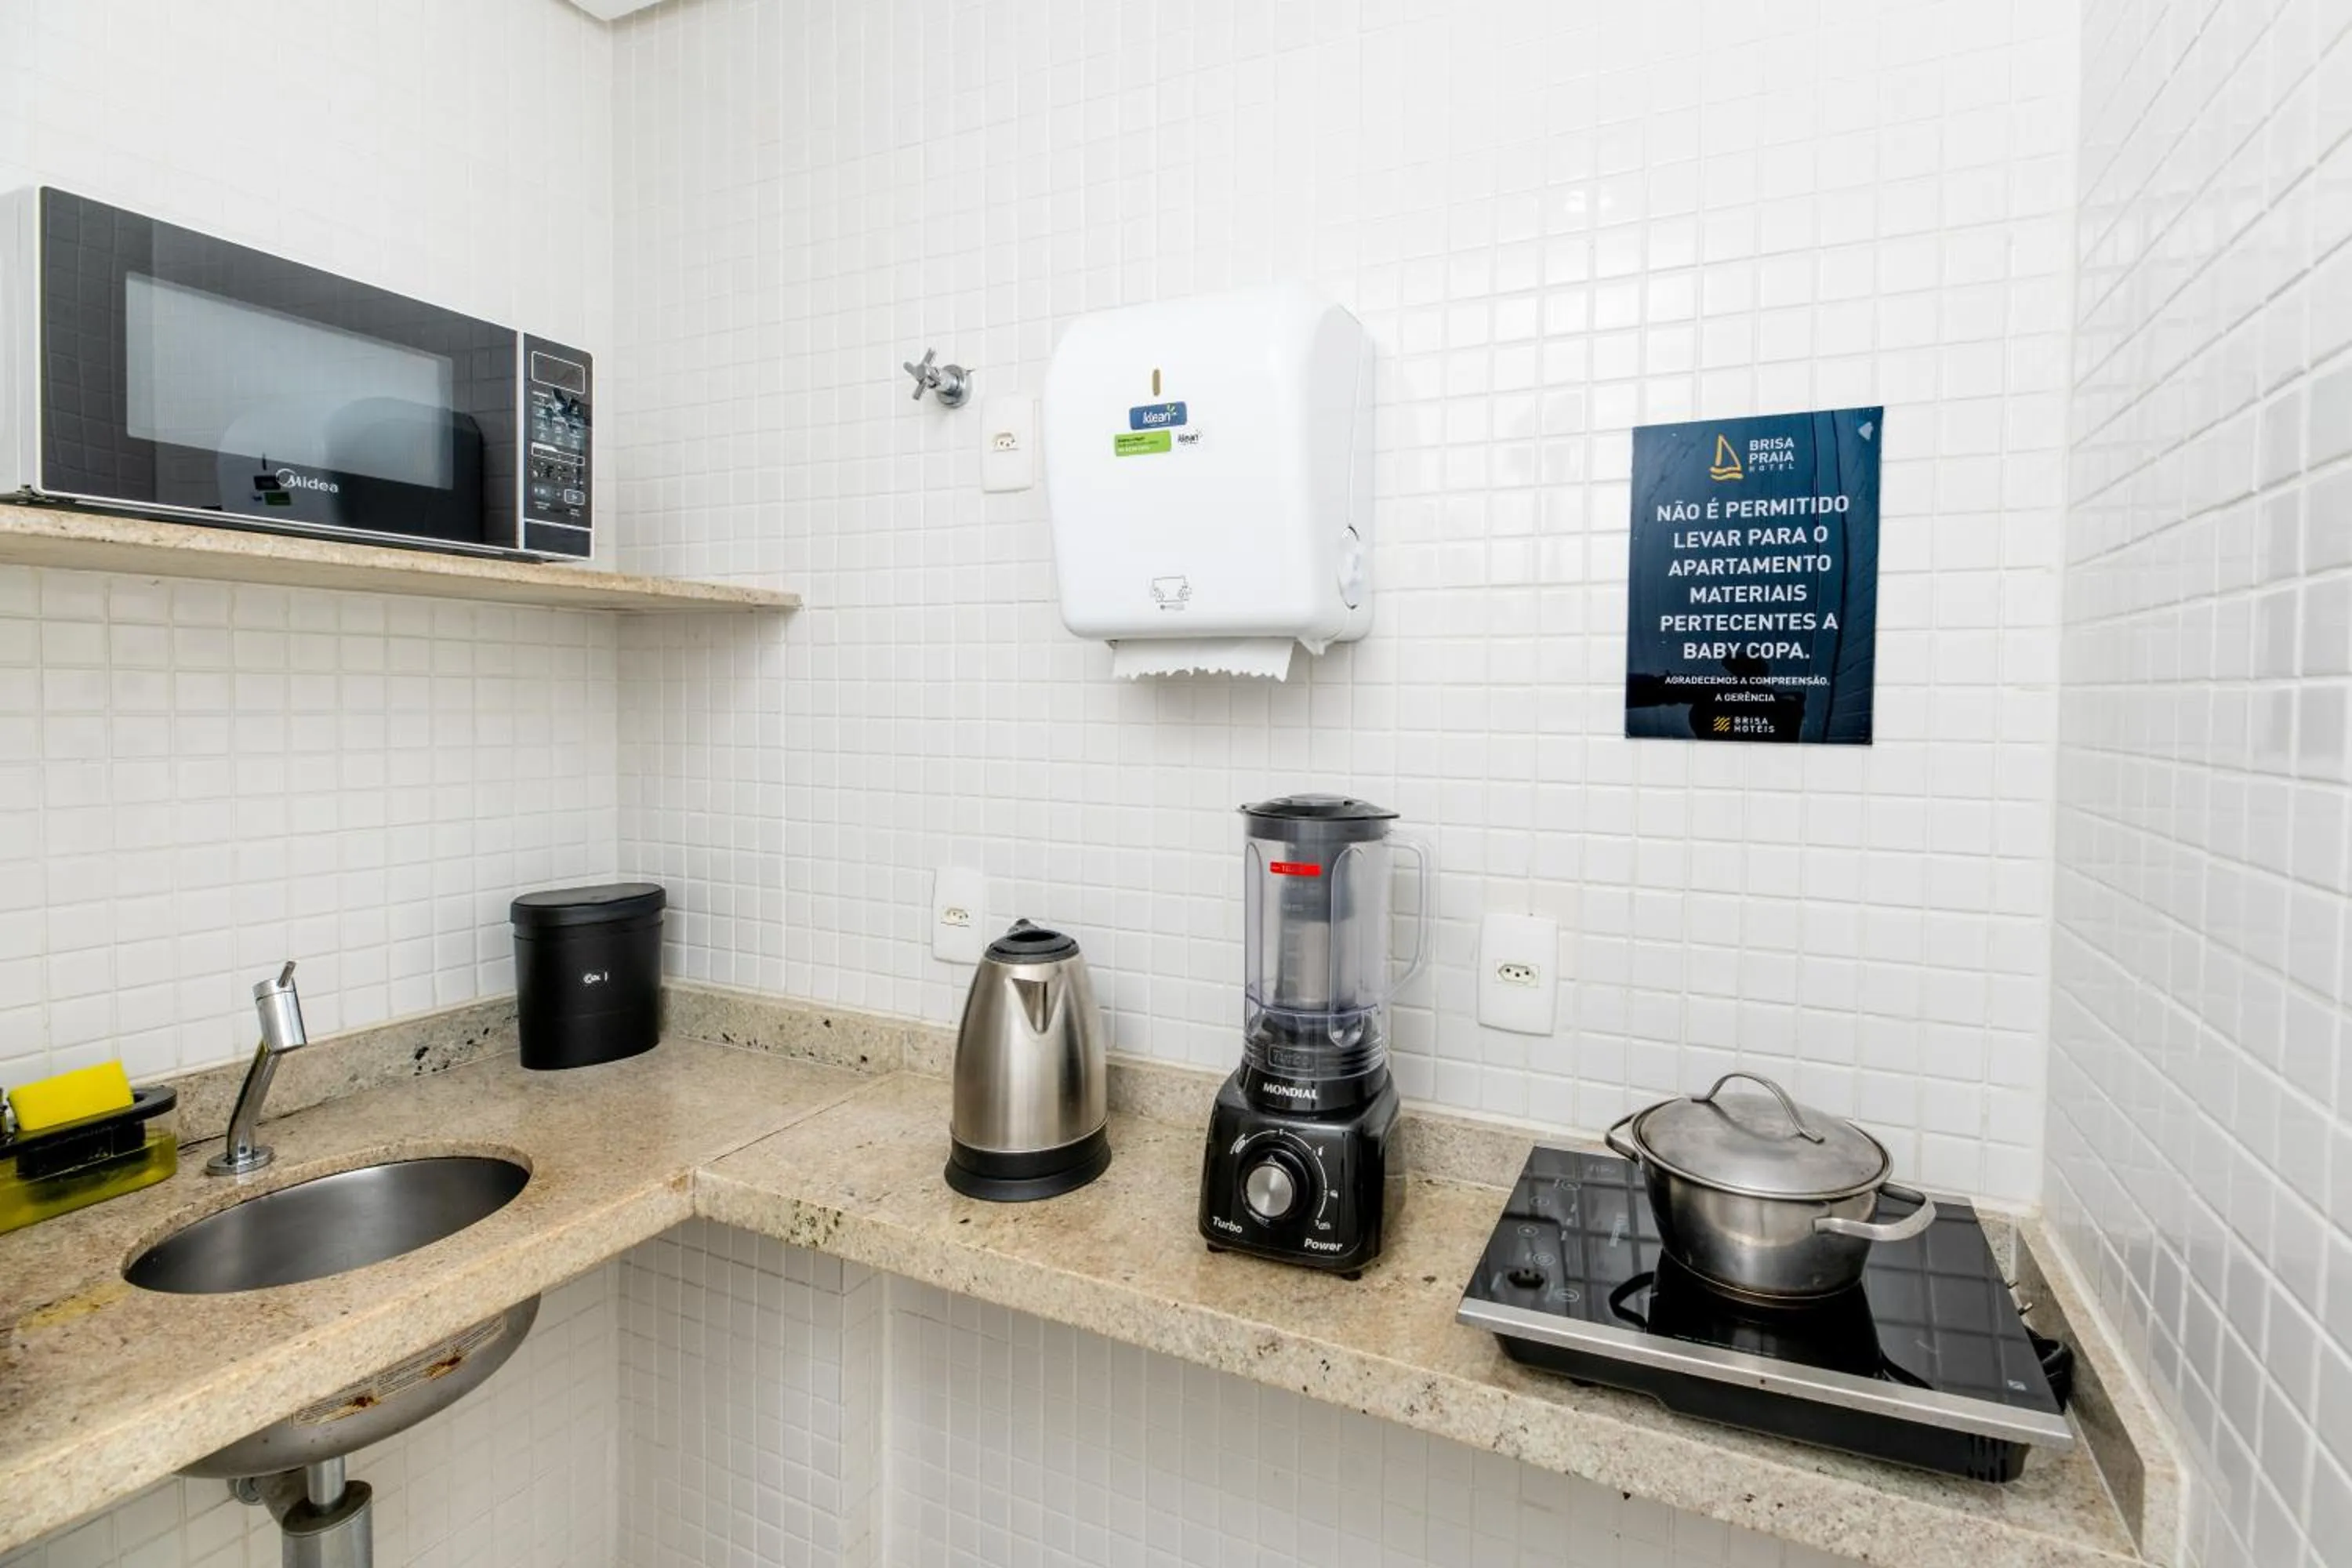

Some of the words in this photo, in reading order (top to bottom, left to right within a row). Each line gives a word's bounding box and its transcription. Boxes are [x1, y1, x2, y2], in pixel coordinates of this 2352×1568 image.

[1748, 437, 1795, 451] BRISA
[1748, 450, 1795, 464] PRAIA
[283, 472, 339, 493] Midea
[1657, 500, 1700, 521] NÃO
[1707, 497, 1719, 519] É
[1726, 495, 1849, 518] PERMITIDO
[1674, 529, 1741, 548] LEVAR
[1748, 526, 1807, 546] PARA
[1813, 525, 1828, 543] O
[1668, 554, 1832, 576] APARTAMENTO
[1690, 584, 1807, 604] MATERIAIS
[1660, 612, 1817, 632] PERTECENTES
[1822, 612, 1838, 630] A
[1683, 642, 1740, 659] BABY
[1746, 642, 1810, 659] COPA.
[1664, 676, 1738, 685] AGRADECEMOS
[1740, 676, 1748, 685] A
[1715, 693, 1723, 702] A
[1724, 691, 1776, 702] GERÊNCIA
[1733, 716, 1769, 725] BRISA
[1263, 1082, 1319, 1099] MONDIAL
[1213, 1216, 1243, 1234] Turbo
[1304, 1238, 1343, 1253] Power
